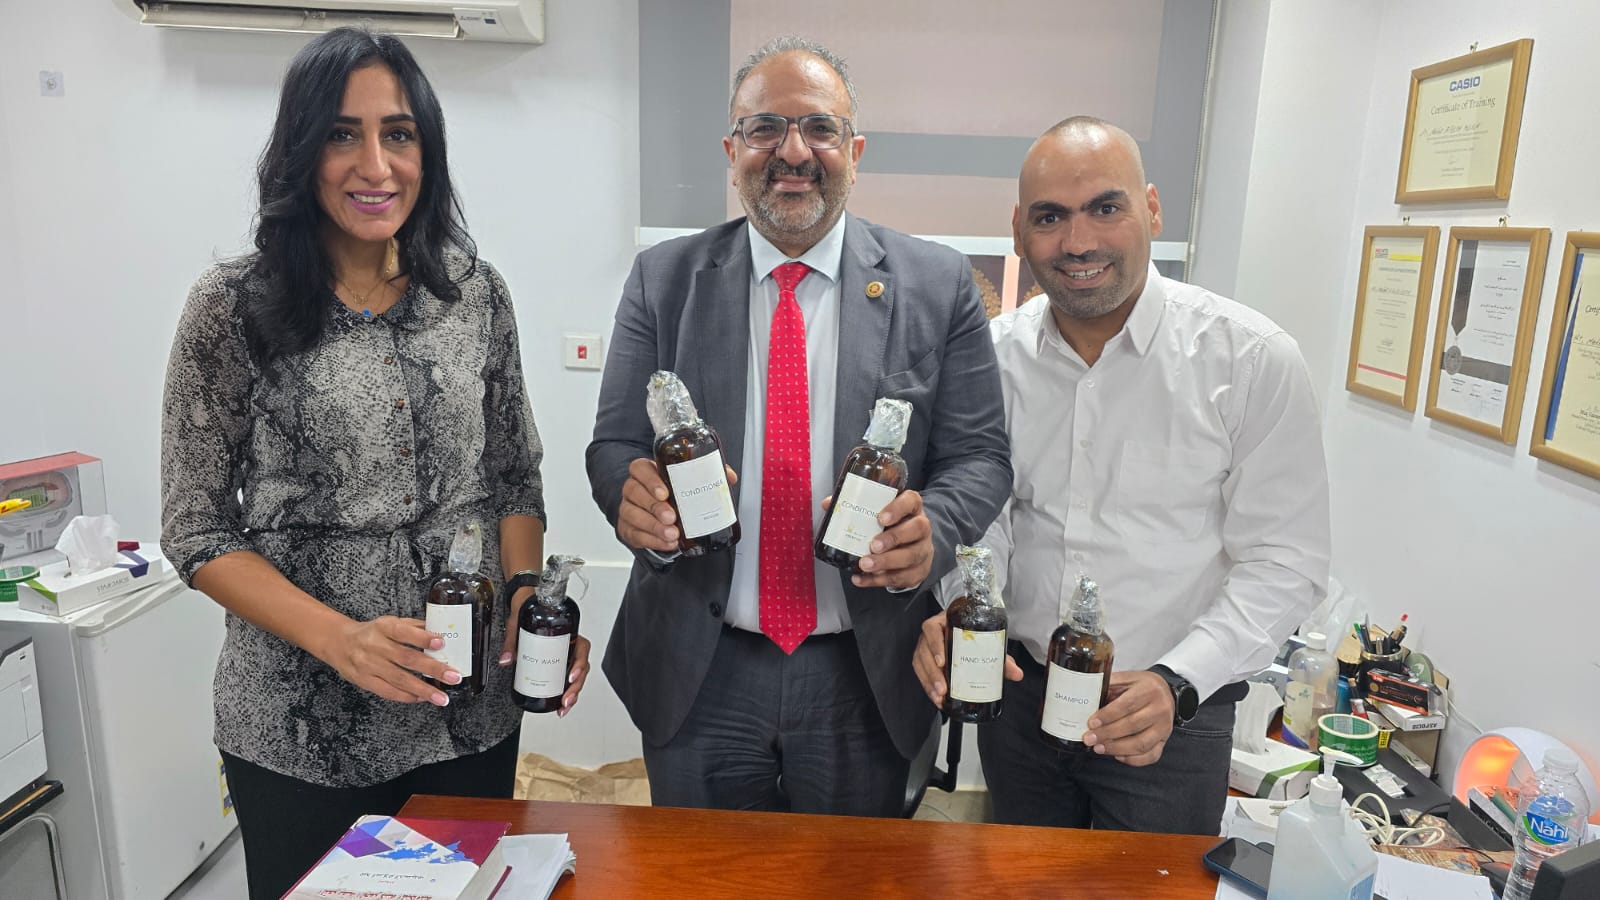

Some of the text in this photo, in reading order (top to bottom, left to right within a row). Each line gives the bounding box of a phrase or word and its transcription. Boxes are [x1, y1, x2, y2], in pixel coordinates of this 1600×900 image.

[1449, 76, 1481, 92] CASIO
[1430, 103, 1461, 115] Certificate
[1468, 95, 1497, 109] Training
[522, 654, 539, 664] BODY
[960, 655, 999, 664] HAND SOAP
[1054, 692, 1089, 705] SHAMPOO
